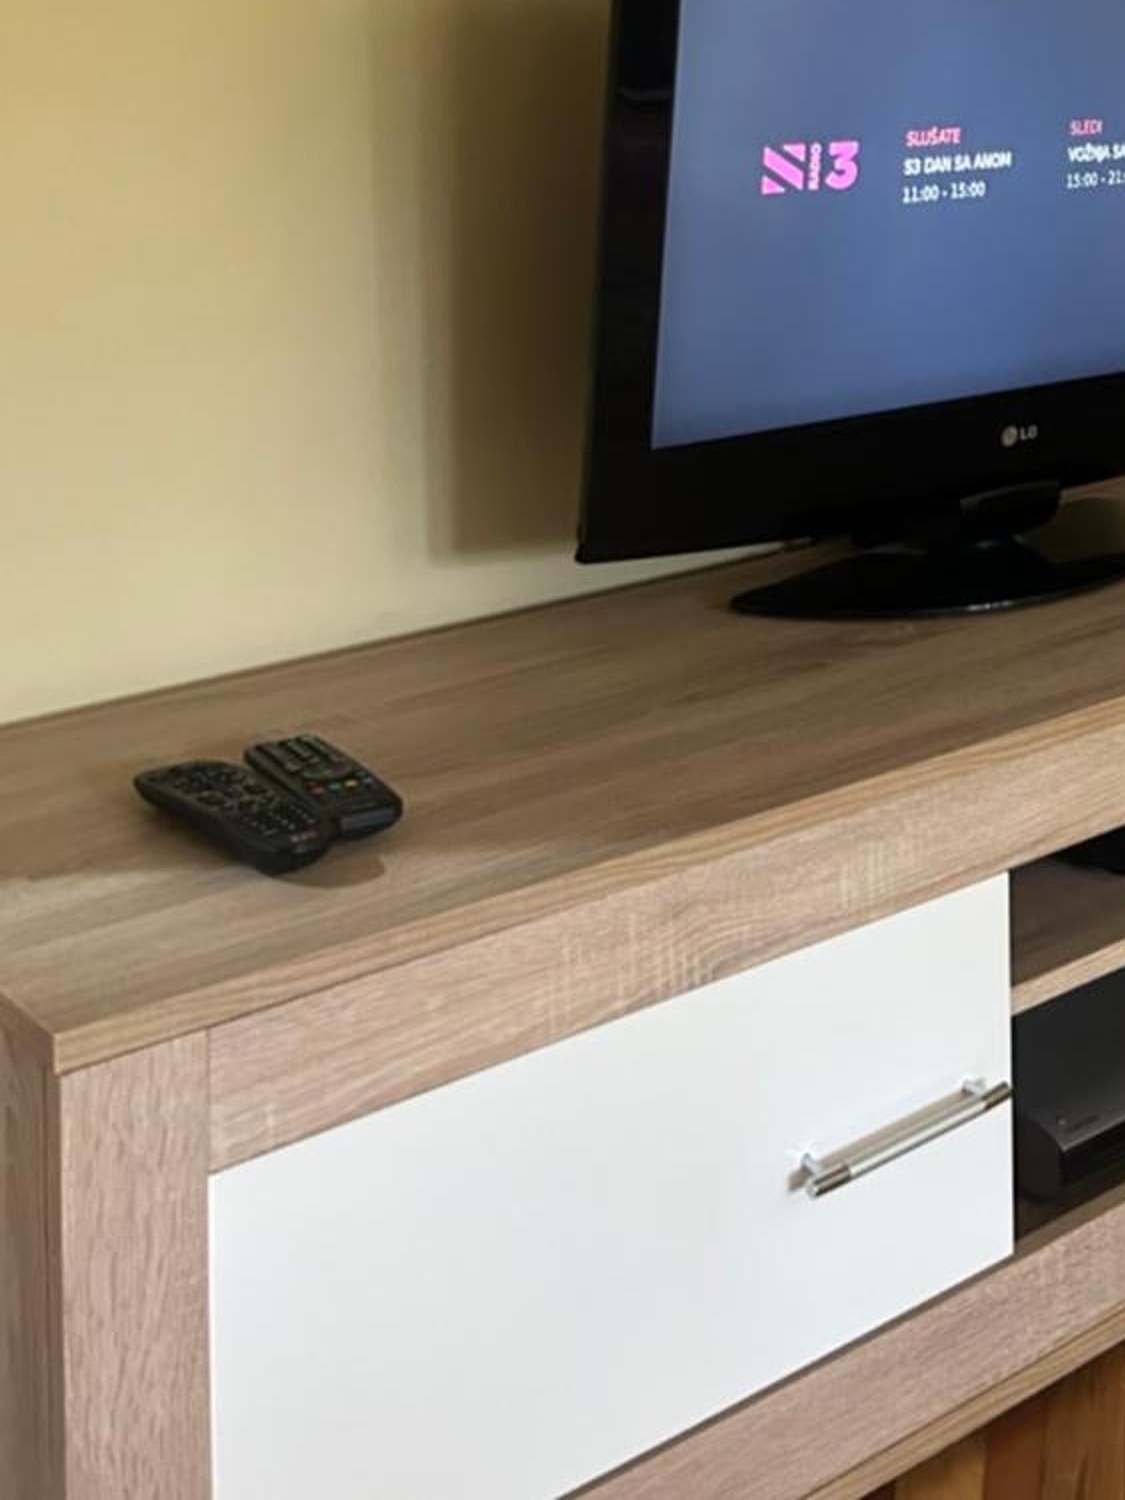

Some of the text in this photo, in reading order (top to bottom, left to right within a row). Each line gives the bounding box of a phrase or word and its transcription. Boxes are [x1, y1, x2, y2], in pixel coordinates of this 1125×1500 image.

[905, 125, 961, 147] SLUŠATE
[923, 154, 953, 175] DAN
[953, 153, 972, 173] SA
[902, 184, 940, 204] 11:00
[949, 179, 987, 200] 15:00
